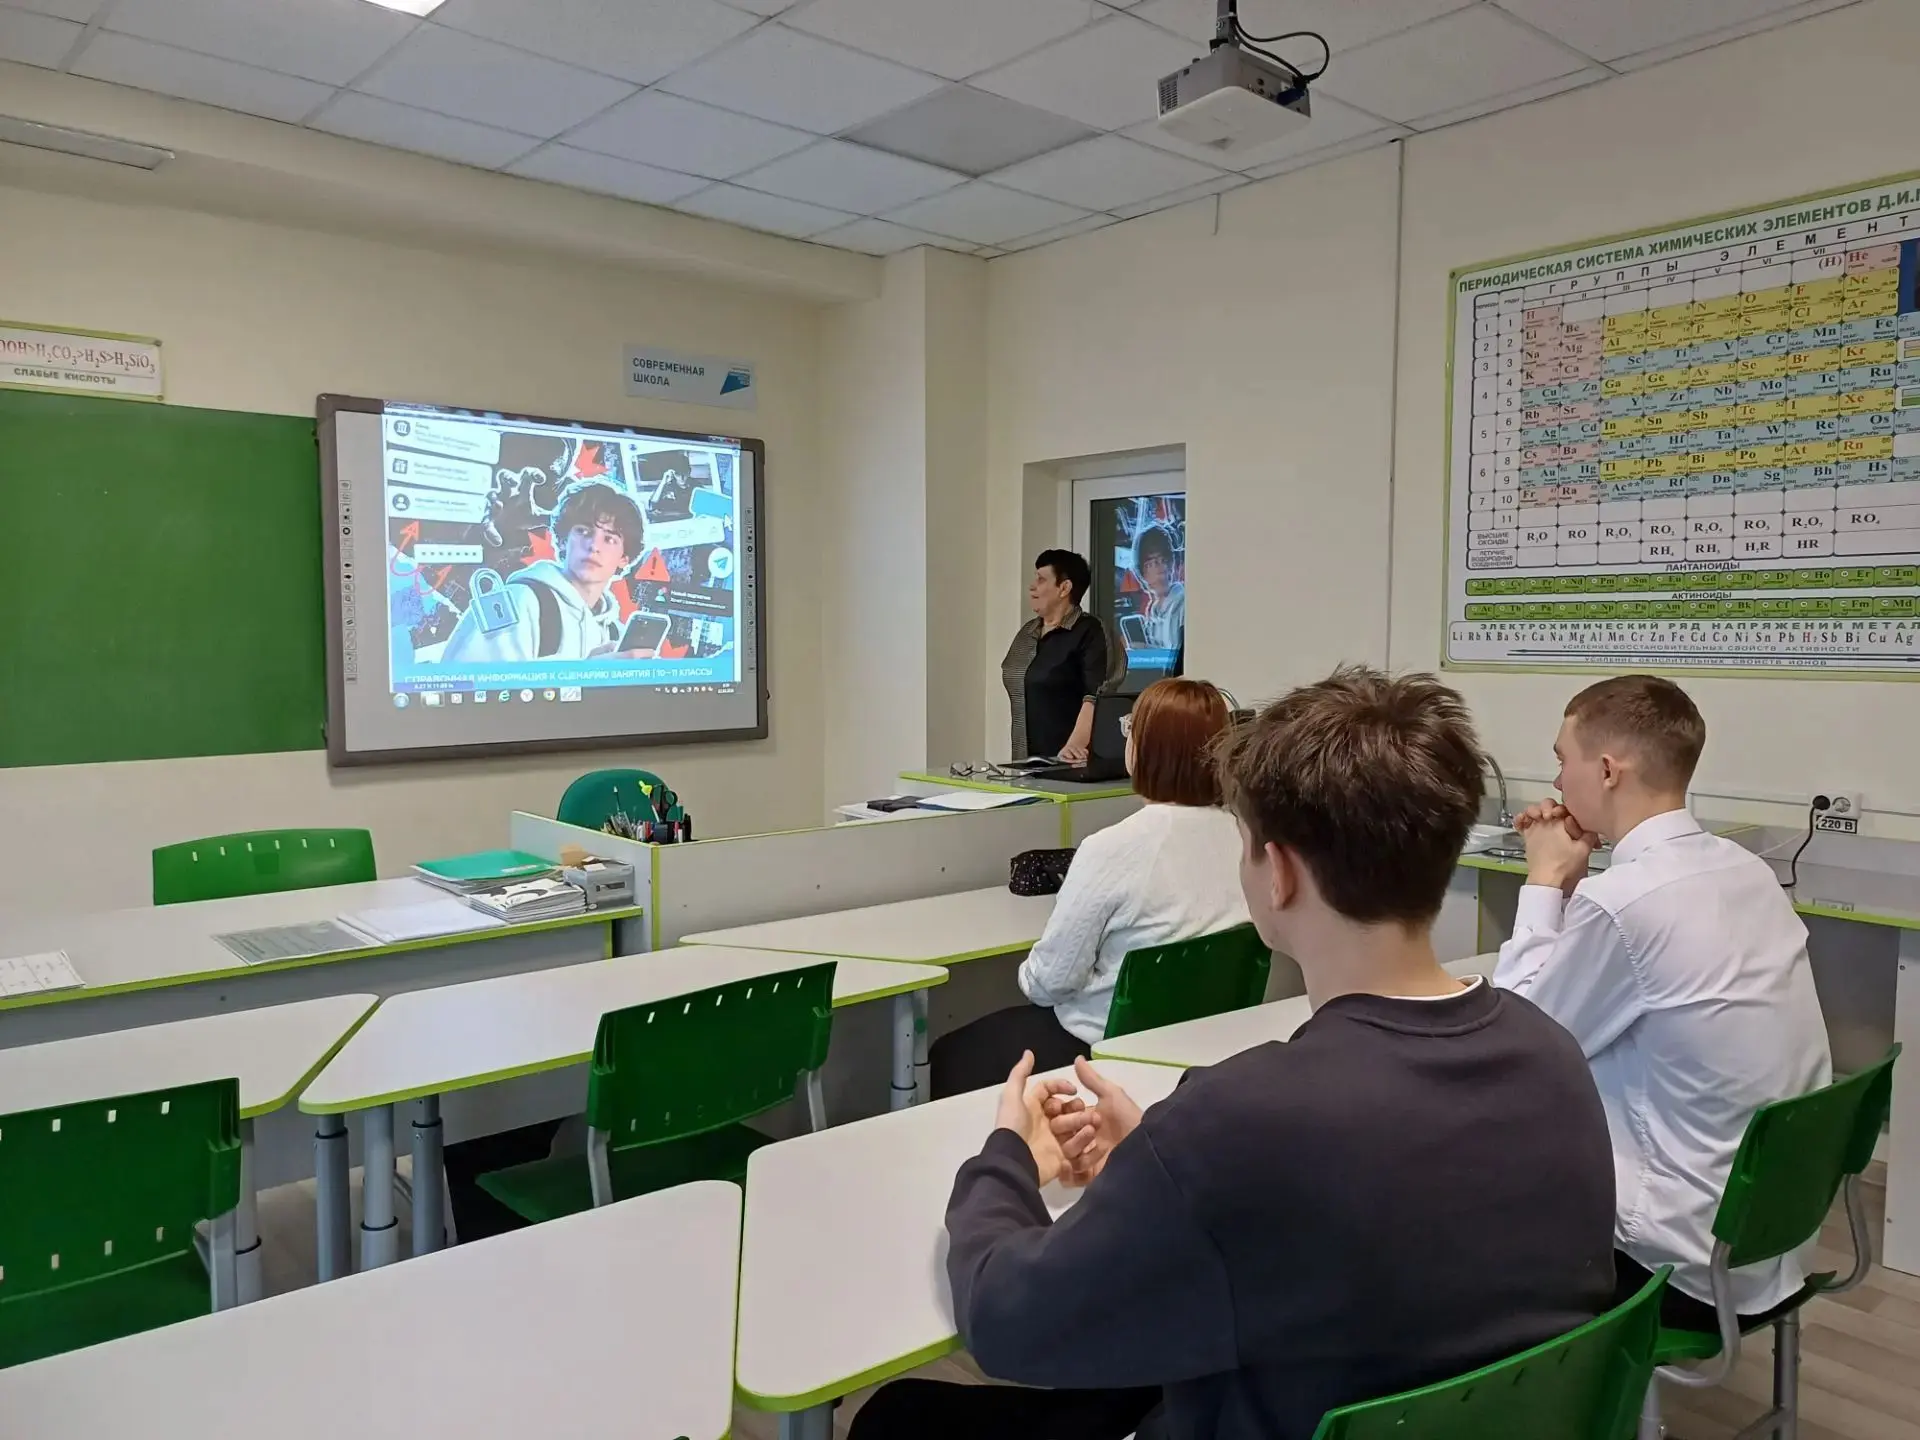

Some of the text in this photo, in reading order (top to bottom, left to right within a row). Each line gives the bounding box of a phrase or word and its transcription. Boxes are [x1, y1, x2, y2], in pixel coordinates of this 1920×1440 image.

[1460, 260, 1572, 292] ПЕРИОДИЧЕСКАЯ
[1577, 246, 1644, 269] СИСТЕМА
[1649, 222, 1757, 255] ХИМИЧЕСКИХ
[1763, 199, 1871, 231] ЭЛЕМЕНТОВ
[1483, 343, 1489, 351] 2
[1507, 339, 1513, 347] 2
[1506, 379, 1512, 387] 4
[1813, 327, 1837, 338] Mn
[633, 357, 705, 376] СОВРЕМЕННАЯ
[1483, 363, 1489, 371] 3
[1507, 359, 1513, 367] 3
[14, 368, 116, 384] СЛАБЫЕ КИСЛОТЫ
[633, 373, 670, 387] ШКОЛА
[1481, 430, 1487, 439] 5
[1506, 417, 1512, 426] 6
[1870, 368, 1891, 377] Ru
[1506, 398, 1512, 406] 5
[1480, 468, 1486, 477] 6
[1505, 457, 1511, 465] 8
[1504, 476, 1510, 484] 9
[1502, 495, 1512, 504] 10
[1665, 563, 1740, 572] ЛАНТАНОИДЫ
[1481, 622, 1659, 630] ЭЛЕКТРОХИМИЧЕСКИЙ
[1712, 621, 1843, 630] НАПРЯЖЕНИЙ
[612, 669, 650, 679] ЗАНЯТИЯ
[679, 668, 713, 677] КЛАССЫ
[1821, 819, 1841, 829] 220
